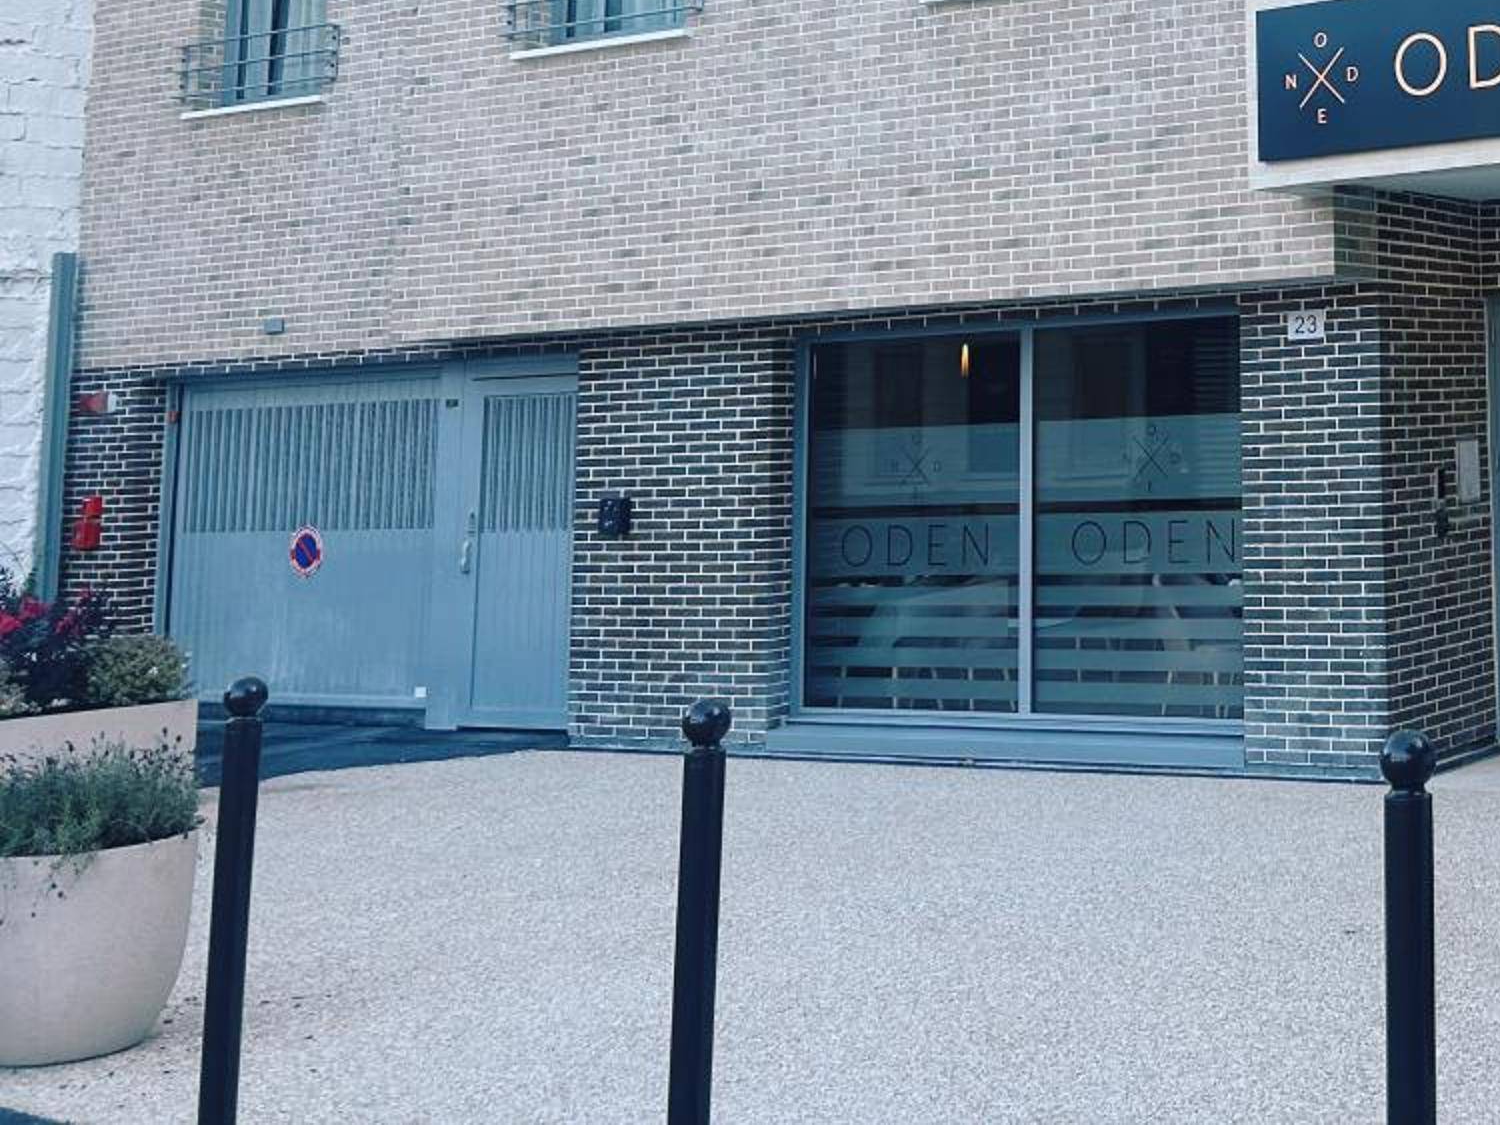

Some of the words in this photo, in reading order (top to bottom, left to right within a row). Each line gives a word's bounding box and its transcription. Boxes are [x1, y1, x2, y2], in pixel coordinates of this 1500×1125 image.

[1313, 32, 1327, 48] O
[1285, 74, 1297, 90] N
[1346, 66, 1359, 82] D
[1317, 108, 1327, 124] E
[1295, 315, 1317, 333] 23
[841, 523, 990, 567] ODEN
[1071, 518, 1236, 565] ODEN
